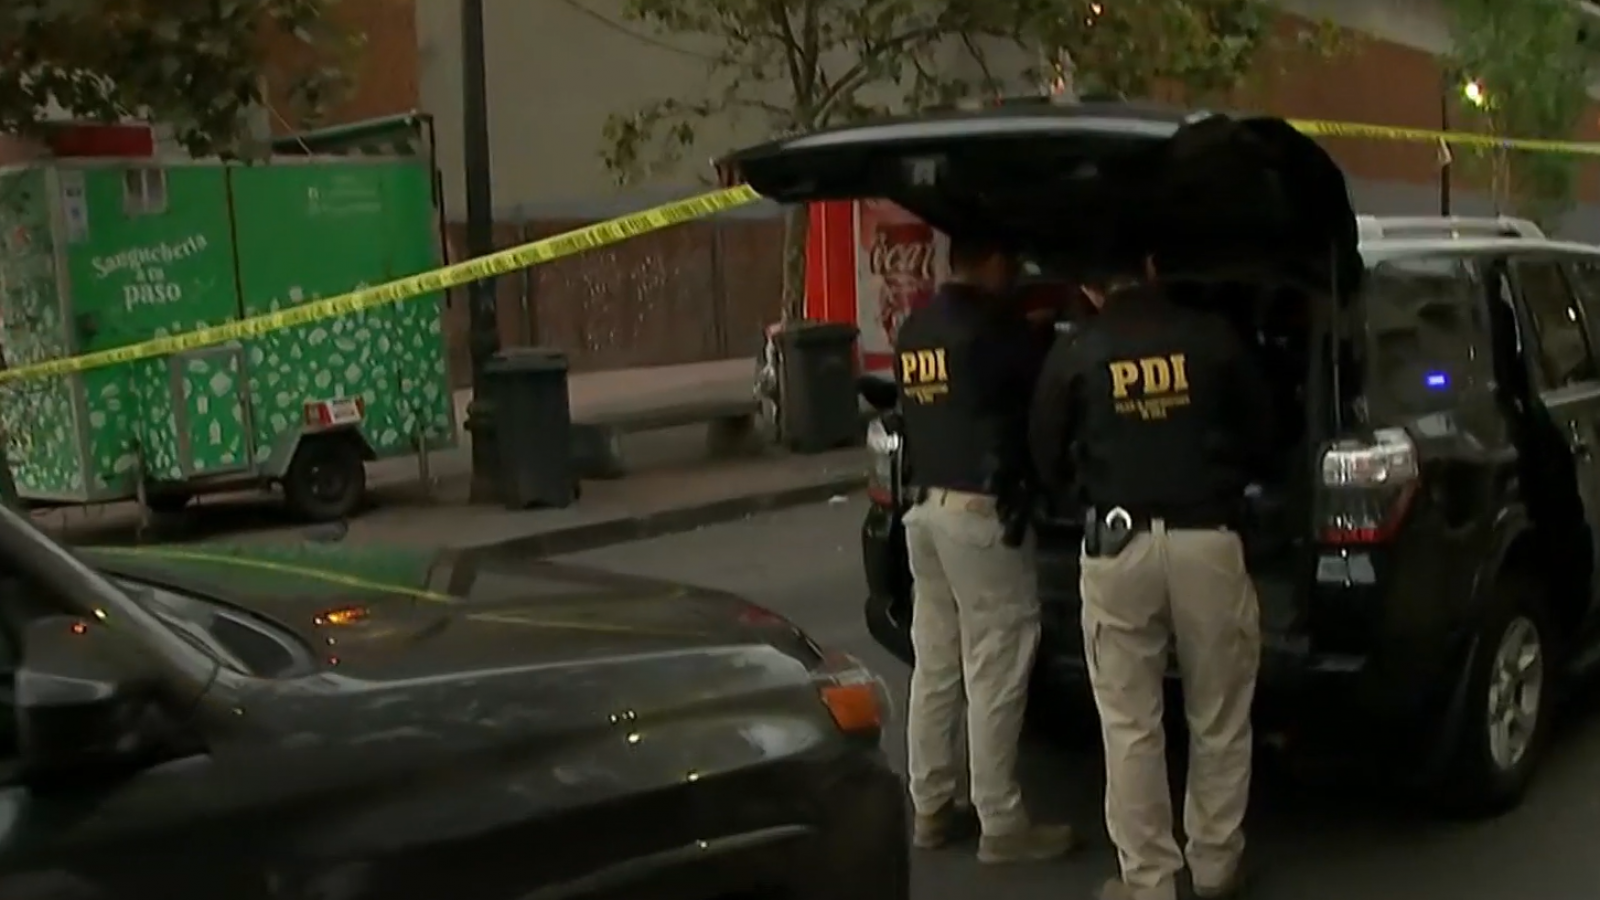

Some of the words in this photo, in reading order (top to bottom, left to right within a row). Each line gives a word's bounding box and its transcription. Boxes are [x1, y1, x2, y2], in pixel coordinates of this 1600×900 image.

[122, 282, 182, 312] paso
[901, 347, 948, 383] PDI
[1109, 353, 1189, 398] PDI
